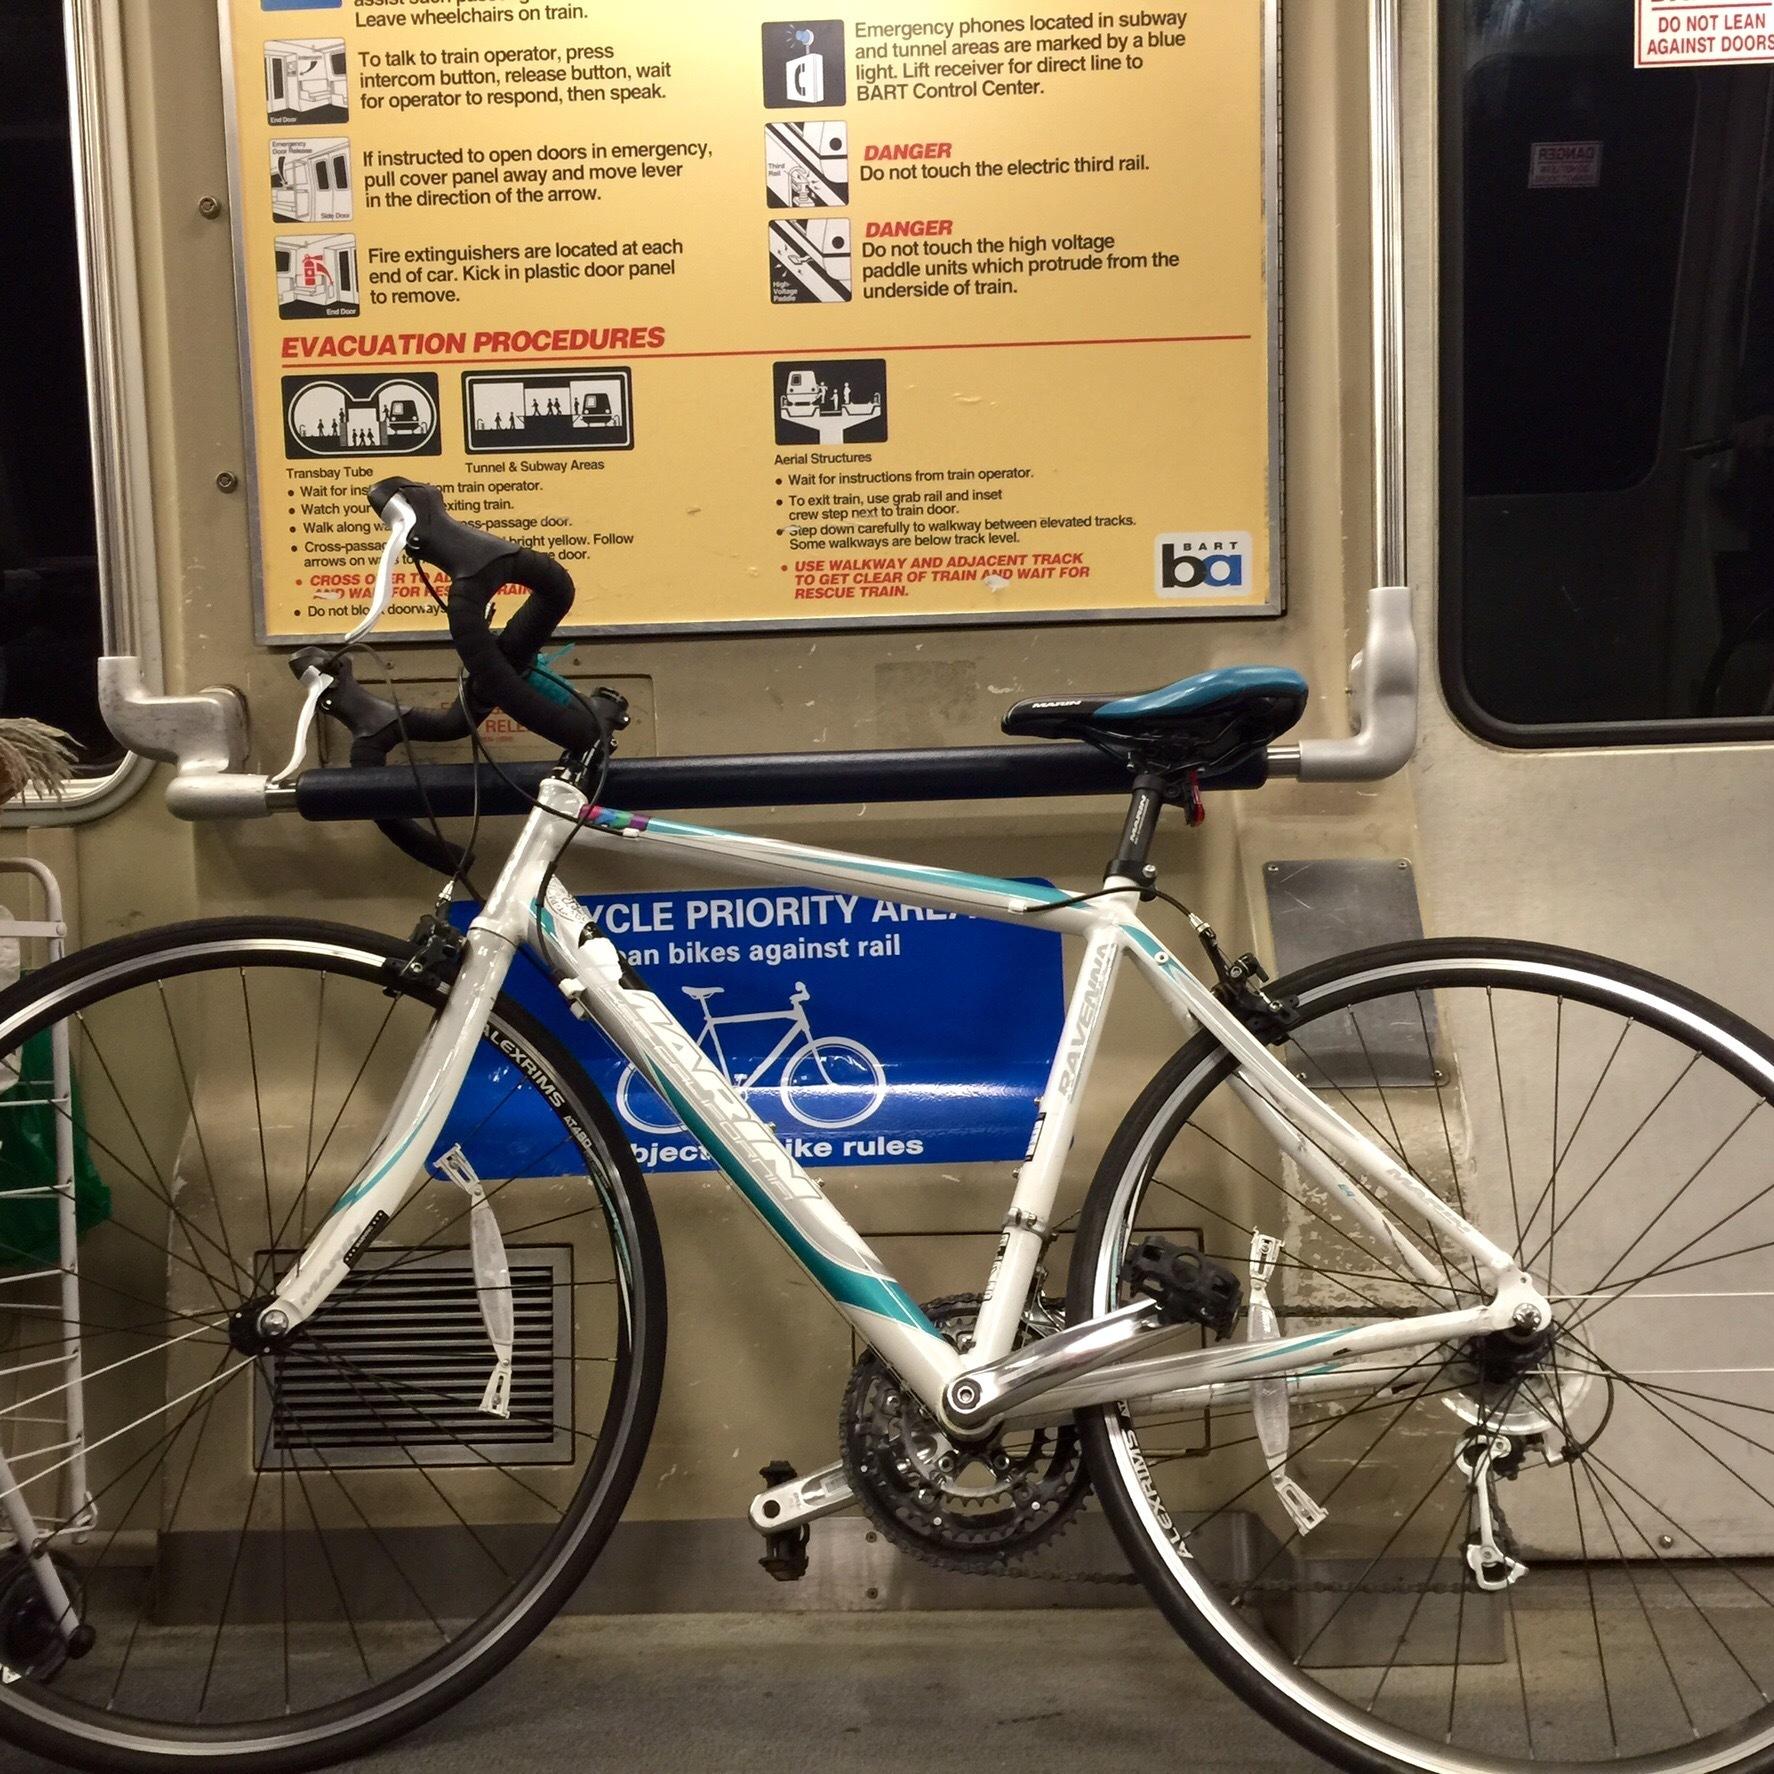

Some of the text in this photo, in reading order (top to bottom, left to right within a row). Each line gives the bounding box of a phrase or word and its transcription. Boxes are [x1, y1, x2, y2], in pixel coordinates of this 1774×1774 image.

[355, 3, 587, 28] Leave wheelchairs on train.
[855, 9, 1188, 40] Emergency phones located in subway
[1658, 13, 1766, 33] DO NOT LEAN
[1647, 34, 1774, 55] AGAINST DOORS
[357, 46, 614, 67] To talk to train operator, press
[360, 61, 671, 88] intercom button, release button, wait
[857, 79, 1044, 101] BART Control Center.
[363, 143, 712, 167] If instructed to open doors in emergency,
[864, 143, 952, 159] DANGER
[860, 154, 1149, 181] Do not touch the electric third rail.
[866, 221, 953, 237] DANGER
[368, 238, 683, 264] Fire extinguishers are located at each
[369, 289, 460, 304] to remove.
[863, 278, 1017, 299] underside of train.
[281, 326, 665, 358] EVACUATION PROCEDURES
[464, 459, 605, 473] Tunnel & Subway Areas
[774, 452, 872, 465] Aerial Structures
[285, 466, 373, 480] Transbay Tube
[788, 467, 1033, 486] Wait for instructions from train operator.
[300, 485, 327, 497] Wait
[329, 485, 347, 497] for
[458, 482, 485, 493] train
[488, 481, 543, 496] operator.
[788, 489, 1002, 507] To exit train, use grab rail and inset
[301, 503, 340, 516] Watch
[342, 505, 370, 517] your
[483, 498, 514, 510] train.
[303, 522, 334, 534] Walk
[336, 522, 371, 535] along
[540, 516, 573, 527] door.
[548, 534, 590, 548] yellow.
[593, 533, 634, 545] Follow
[789, 531, 1020, 550] Some walkways are below track level.
[1183, 541, 1239, 551] BART
[304, 557, 346, 568] arrows
[349, 556, 366, 567] on
[558, 549, 590, 561] door.
[795, 552, 1083, 572] USE WALKWAY AND ADJACENT TRACK
[310, 573, 361, 587] CROSS
[392, 586, 421, 599] FOR
[794, 585, 908, 599] RESCUE TRAIN.
[308, 605, 326, 617] Do
[328, 604, 348, 616] not
[1031, 699, 1082, 709] MARIN
[687, 895, 858, 930] PRIORITY
[668, 941, 741, 965] bikes
[749, 937, 849, 966] against
[857, 933, 900, 957] rail
[1057, 943, 1117, 1098] RAVENNA
[842, 1136, 924, 1157] rules
[1125, 1429, 1195, 1560] ALEXRIMS
